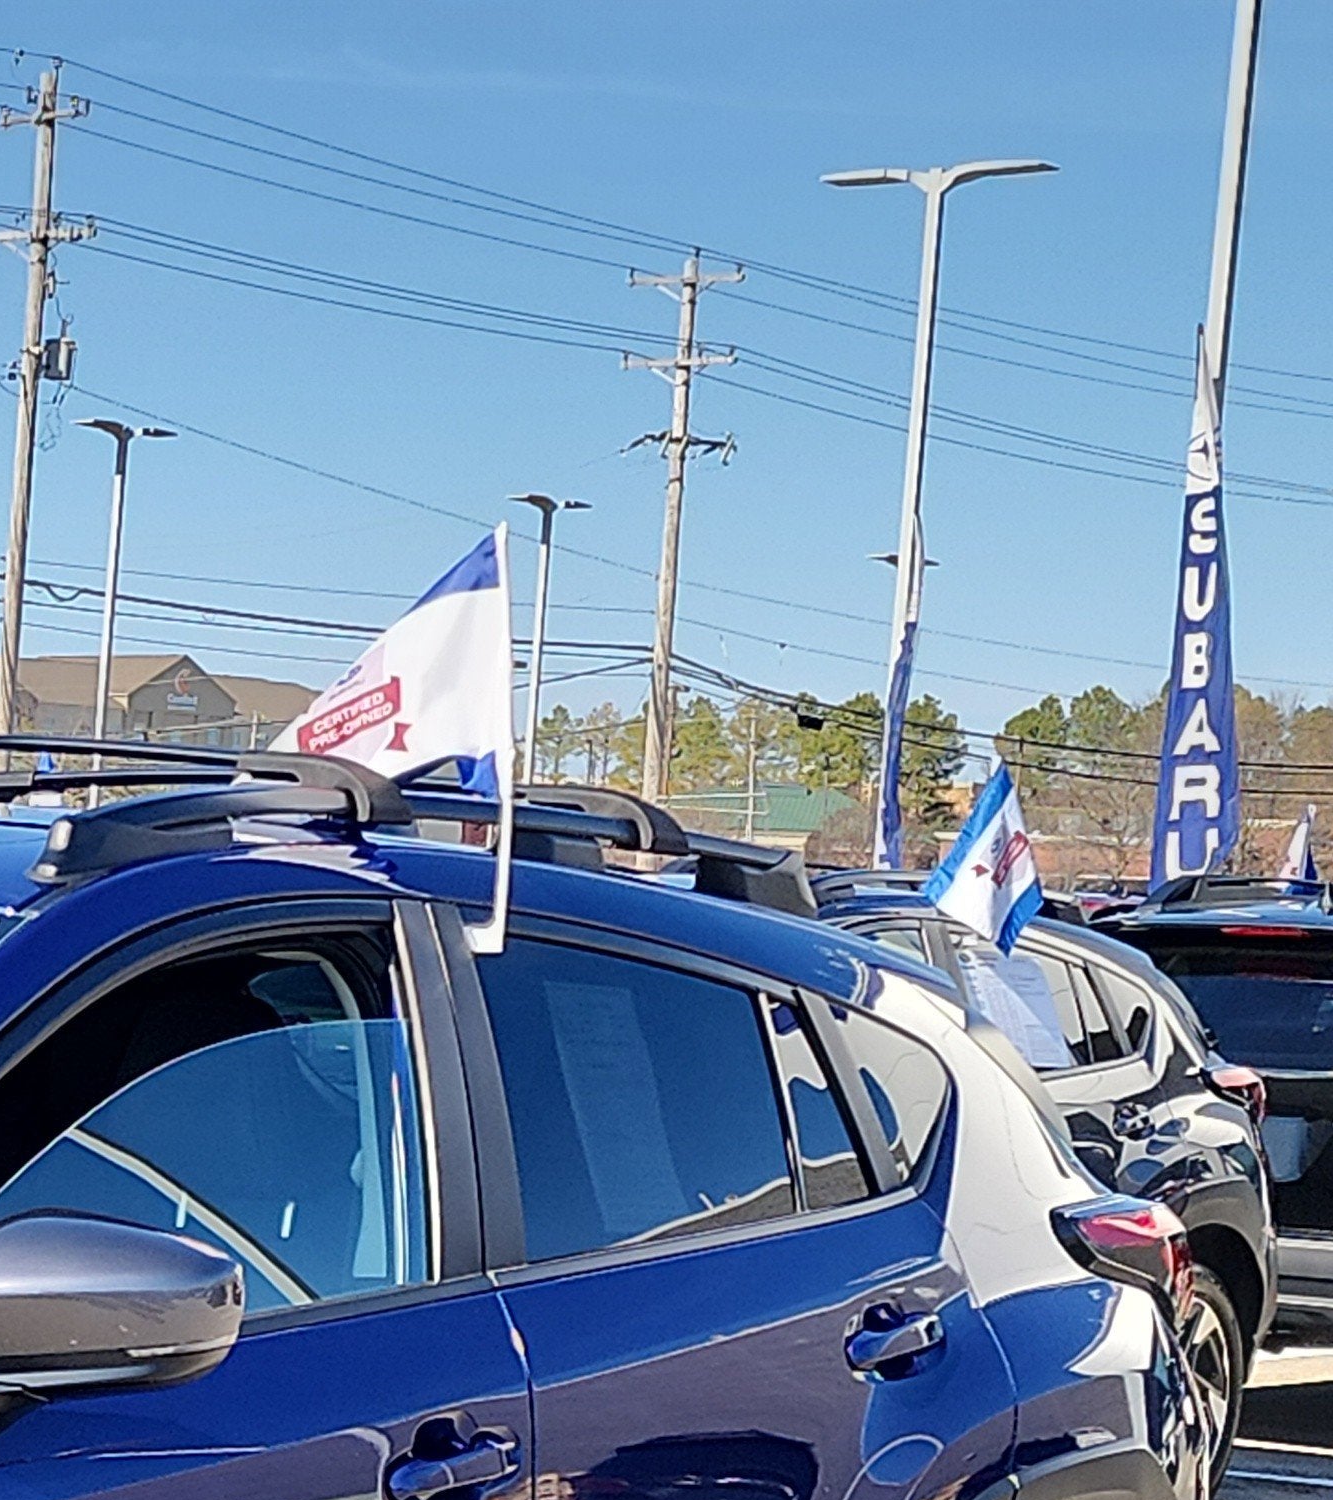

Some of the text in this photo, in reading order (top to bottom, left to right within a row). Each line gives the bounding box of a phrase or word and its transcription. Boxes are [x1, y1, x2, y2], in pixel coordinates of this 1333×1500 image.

[312, 691, 384, 735] CERTIFIED
[1165, 498, 1221, 881] SUBARU
[308, 701, 393, 751] PRE-OWNED
